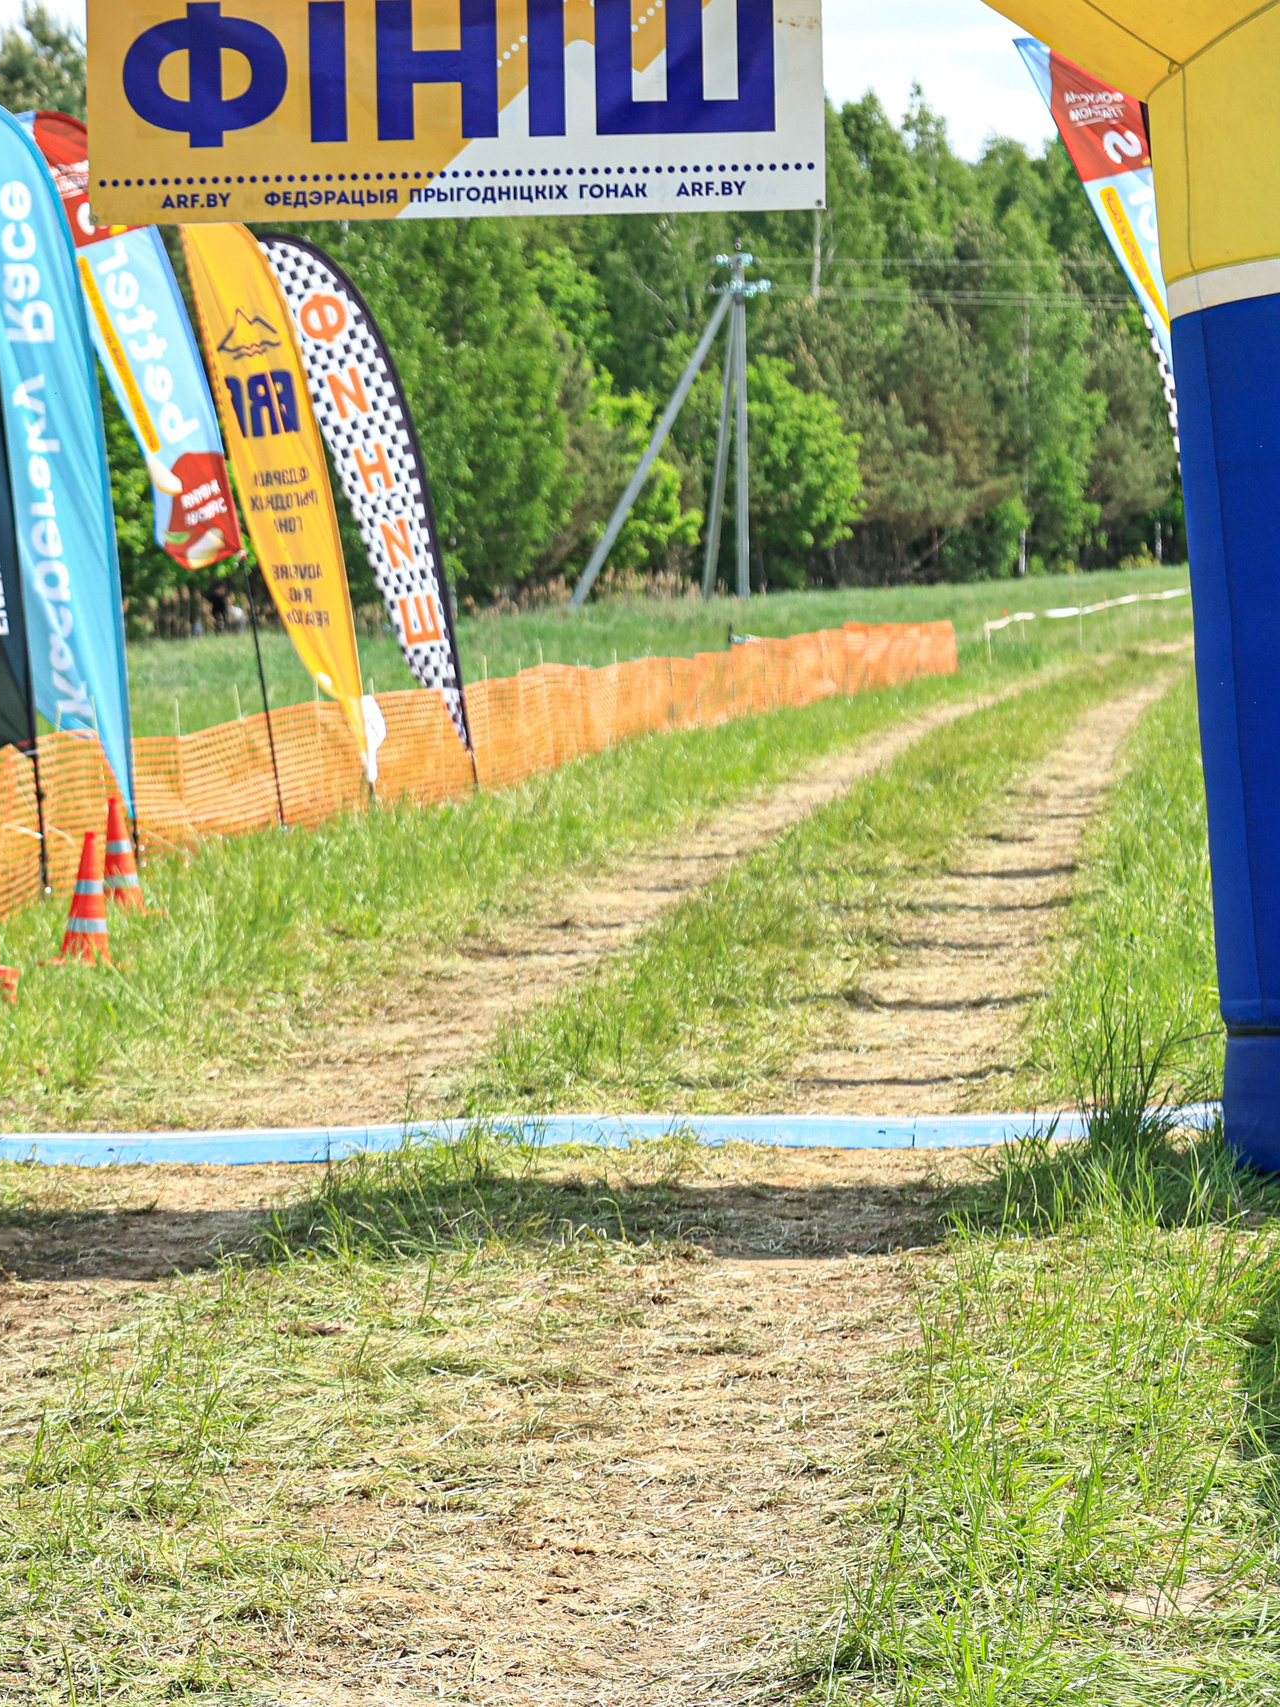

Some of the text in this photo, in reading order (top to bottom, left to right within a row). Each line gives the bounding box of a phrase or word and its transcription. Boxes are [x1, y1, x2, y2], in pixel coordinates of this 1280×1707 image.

[122, 0, 776, 148] ФІНІШ
[264, 181, 648, 208] ФЕДЭРАЦЫЯ ПРЫГОДНІЦКІХ ГОНАК
[676, 179, 747, 198] ARF.BY
[161, 192, 231, 210] ARF.BY
